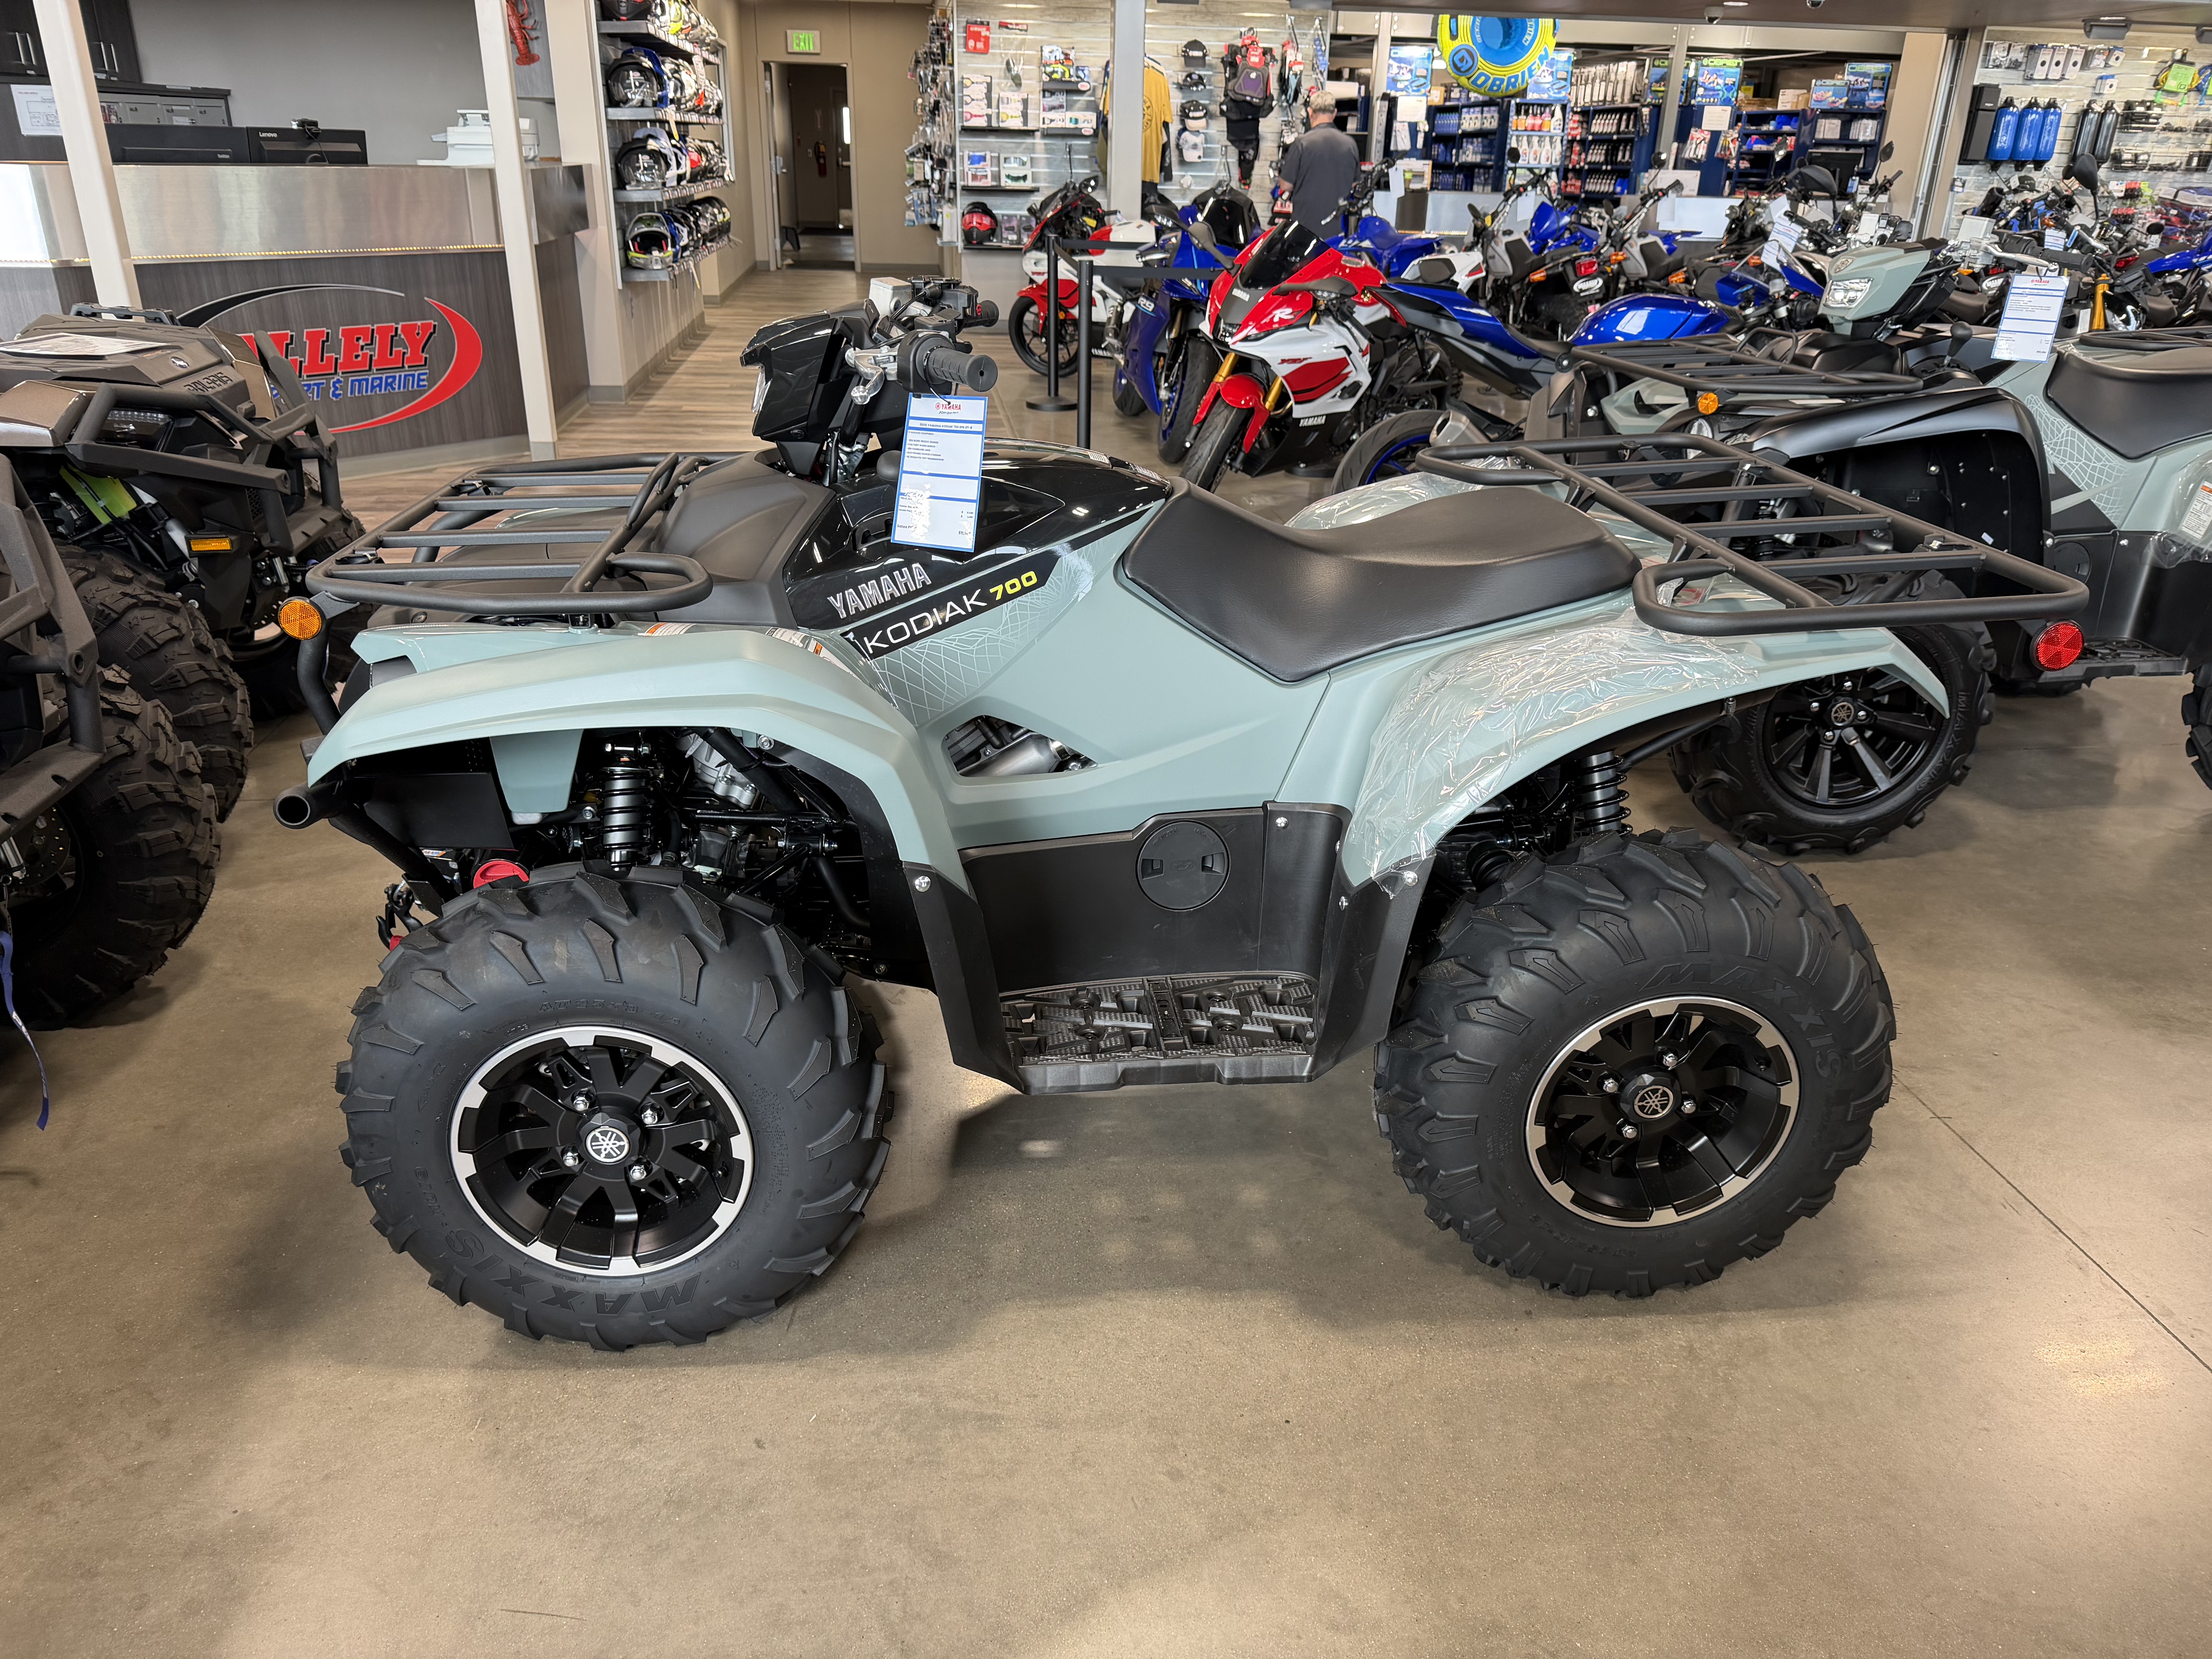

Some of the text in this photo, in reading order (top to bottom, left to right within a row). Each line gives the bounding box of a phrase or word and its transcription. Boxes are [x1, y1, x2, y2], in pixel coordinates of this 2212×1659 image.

[793, 33, 814, 51] EXIT
[1470, 46, 1550, 93] OBRIEN
[1138, 297, 1155, 312] R9
[239, 321, 438, 379] LLELY
[183, 372, 233, 392] POLARIS
[348, 370, 429, 397] MARINE
[1299, 415, 1326, 427] YAMAHA
[827, 563, 932, 619] YAMAHA
[864, 588, 988, 654] KODIAK
[989, 570, 1038, 600] 700
[1639, 963, 1843, 1078] MAXXIS
[445, 1228, 702, 1316] MAXXIS
